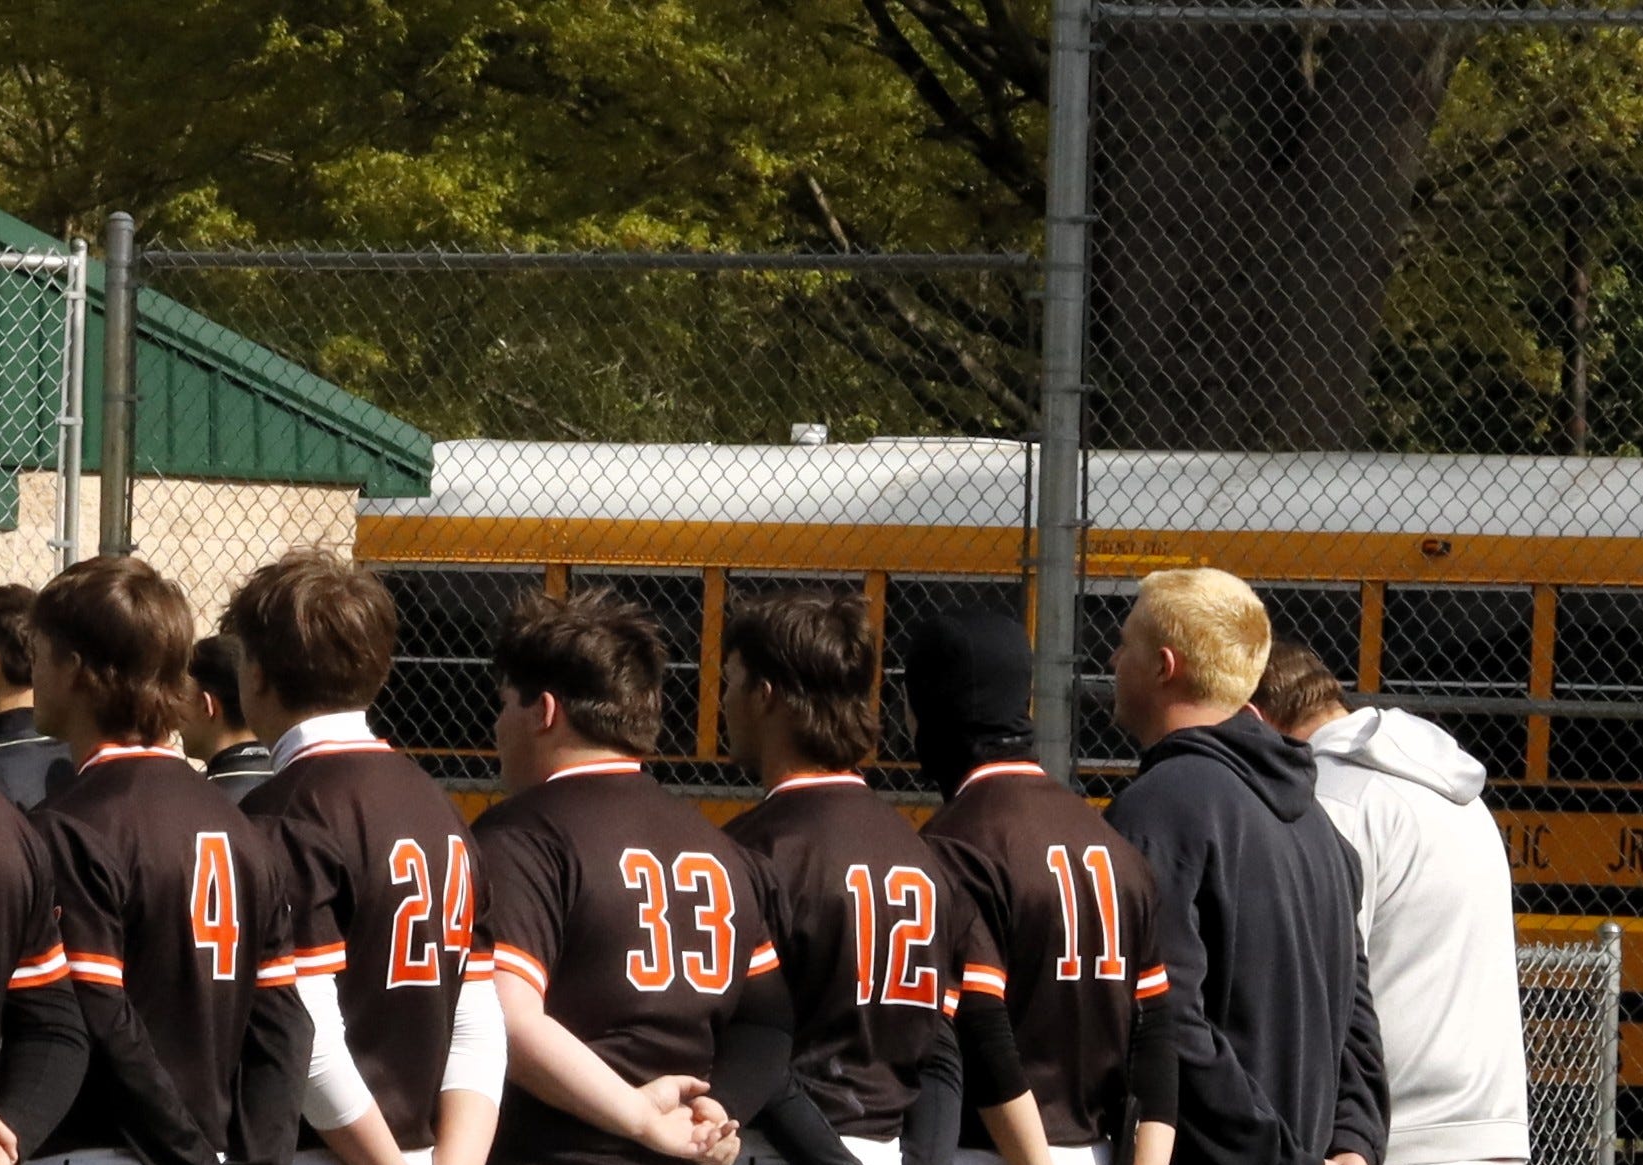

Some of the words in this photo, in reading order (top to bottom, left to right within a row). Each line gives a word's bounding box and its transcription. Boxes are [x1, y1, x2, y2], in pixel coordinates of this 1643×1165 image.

[190, 832, 239, 980] 4
[386, 834, 475, 989] 24
[619, 848, 736, 995] 33
[845, 864, 938, 1010] 12
[1046, 844, 1126, 981] 11
